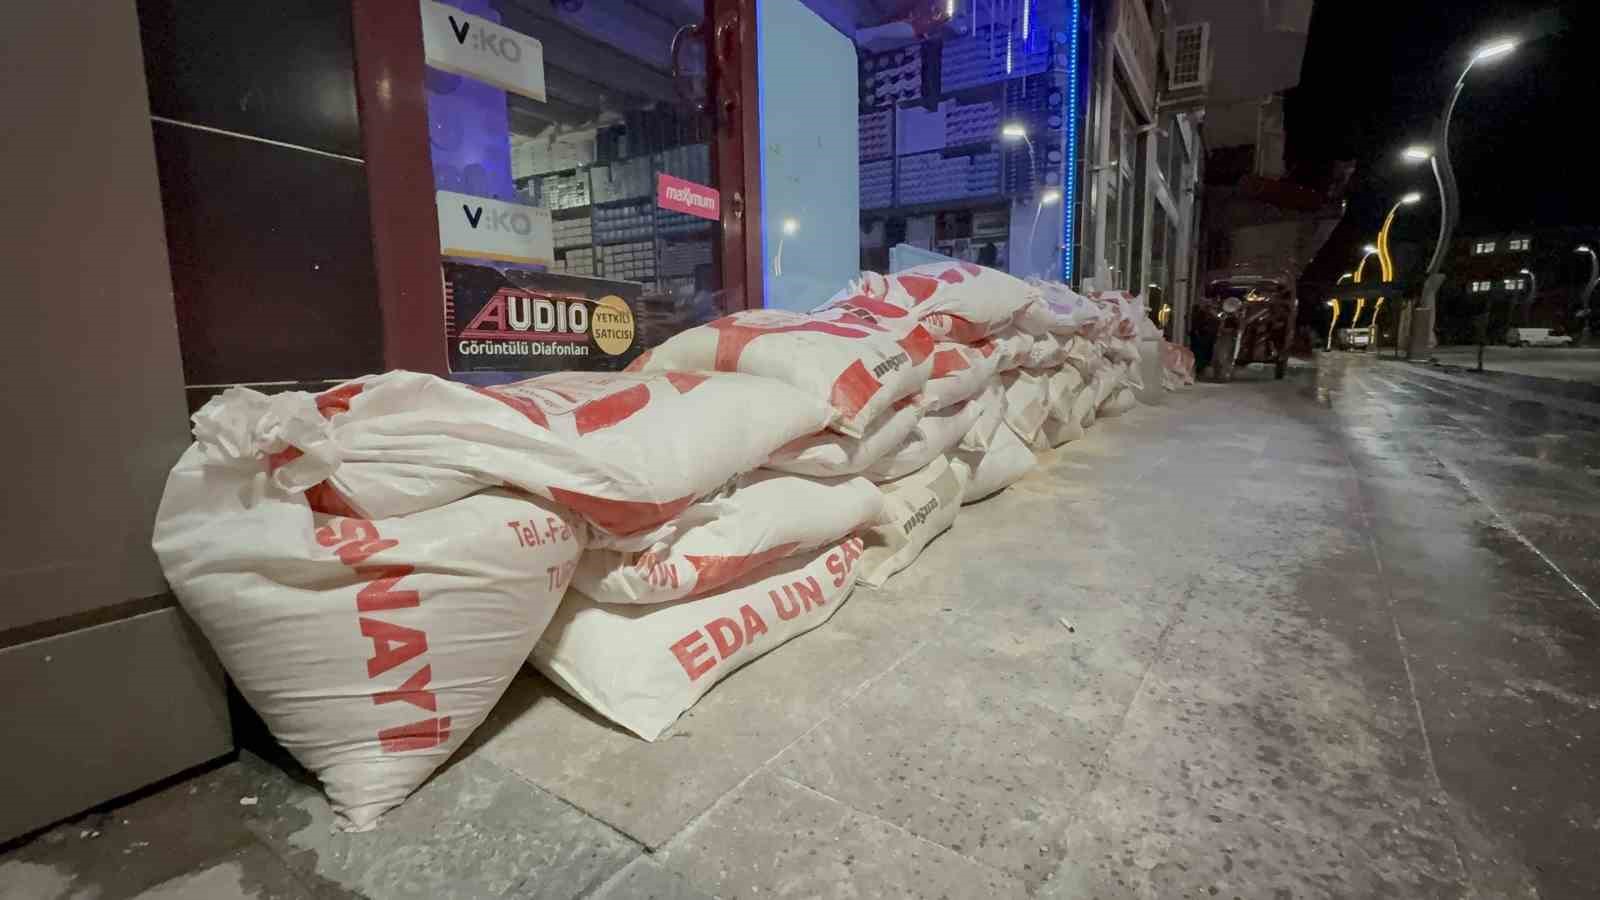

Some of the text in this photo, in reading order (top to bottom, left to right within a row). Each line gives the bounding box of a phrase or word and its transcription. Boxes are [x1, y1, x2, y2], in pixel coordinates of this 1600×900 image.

[460, 288, 589, 339] AUDIO
[459, 340, 589, 356] Görüntülü Diafonları
[595, 328, 632, 339] SATICISI
[669, 603, 768, 682] EDA
[768, 576, 825, 621] UN
